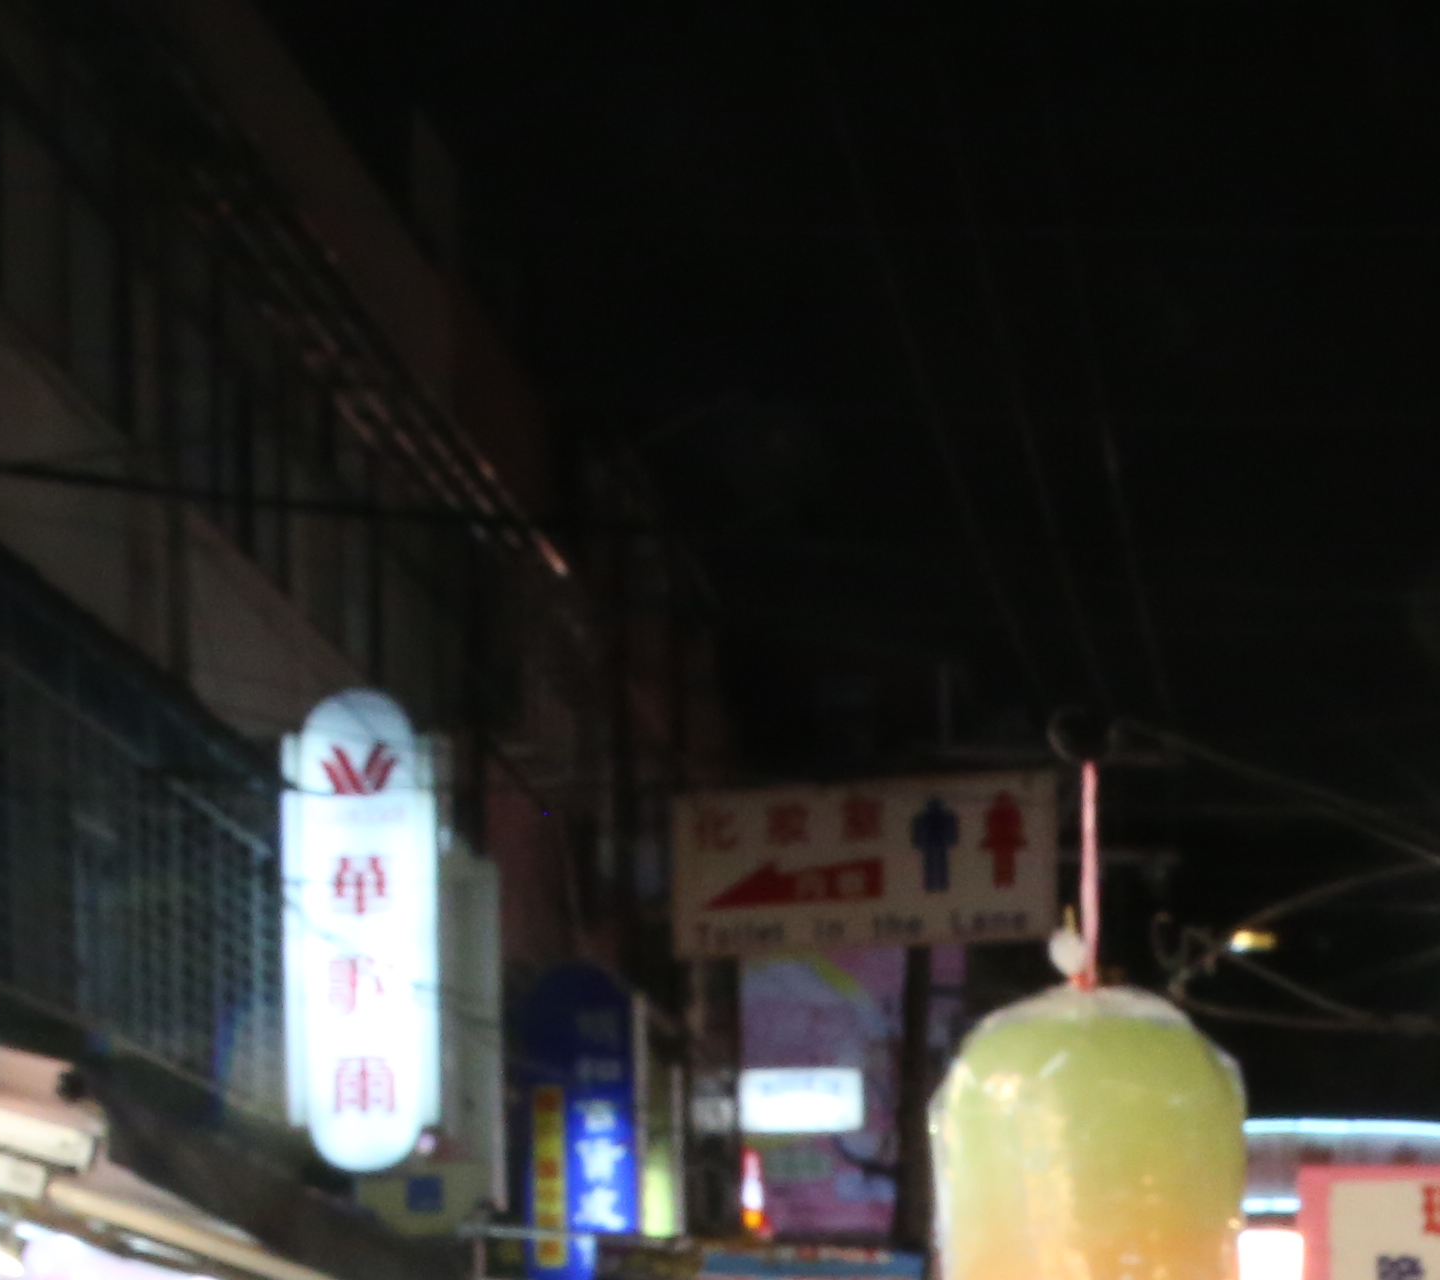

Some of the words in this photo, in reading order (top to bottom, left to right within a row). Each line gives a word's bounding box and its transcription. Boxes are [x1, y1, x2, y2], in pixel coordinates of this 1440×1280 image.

[696, 921, 784, 947] Toilet
[814, 917, 845, 939] in
[873, 914, 924, 938] the
[950, 909, 1027, 935] Lane
